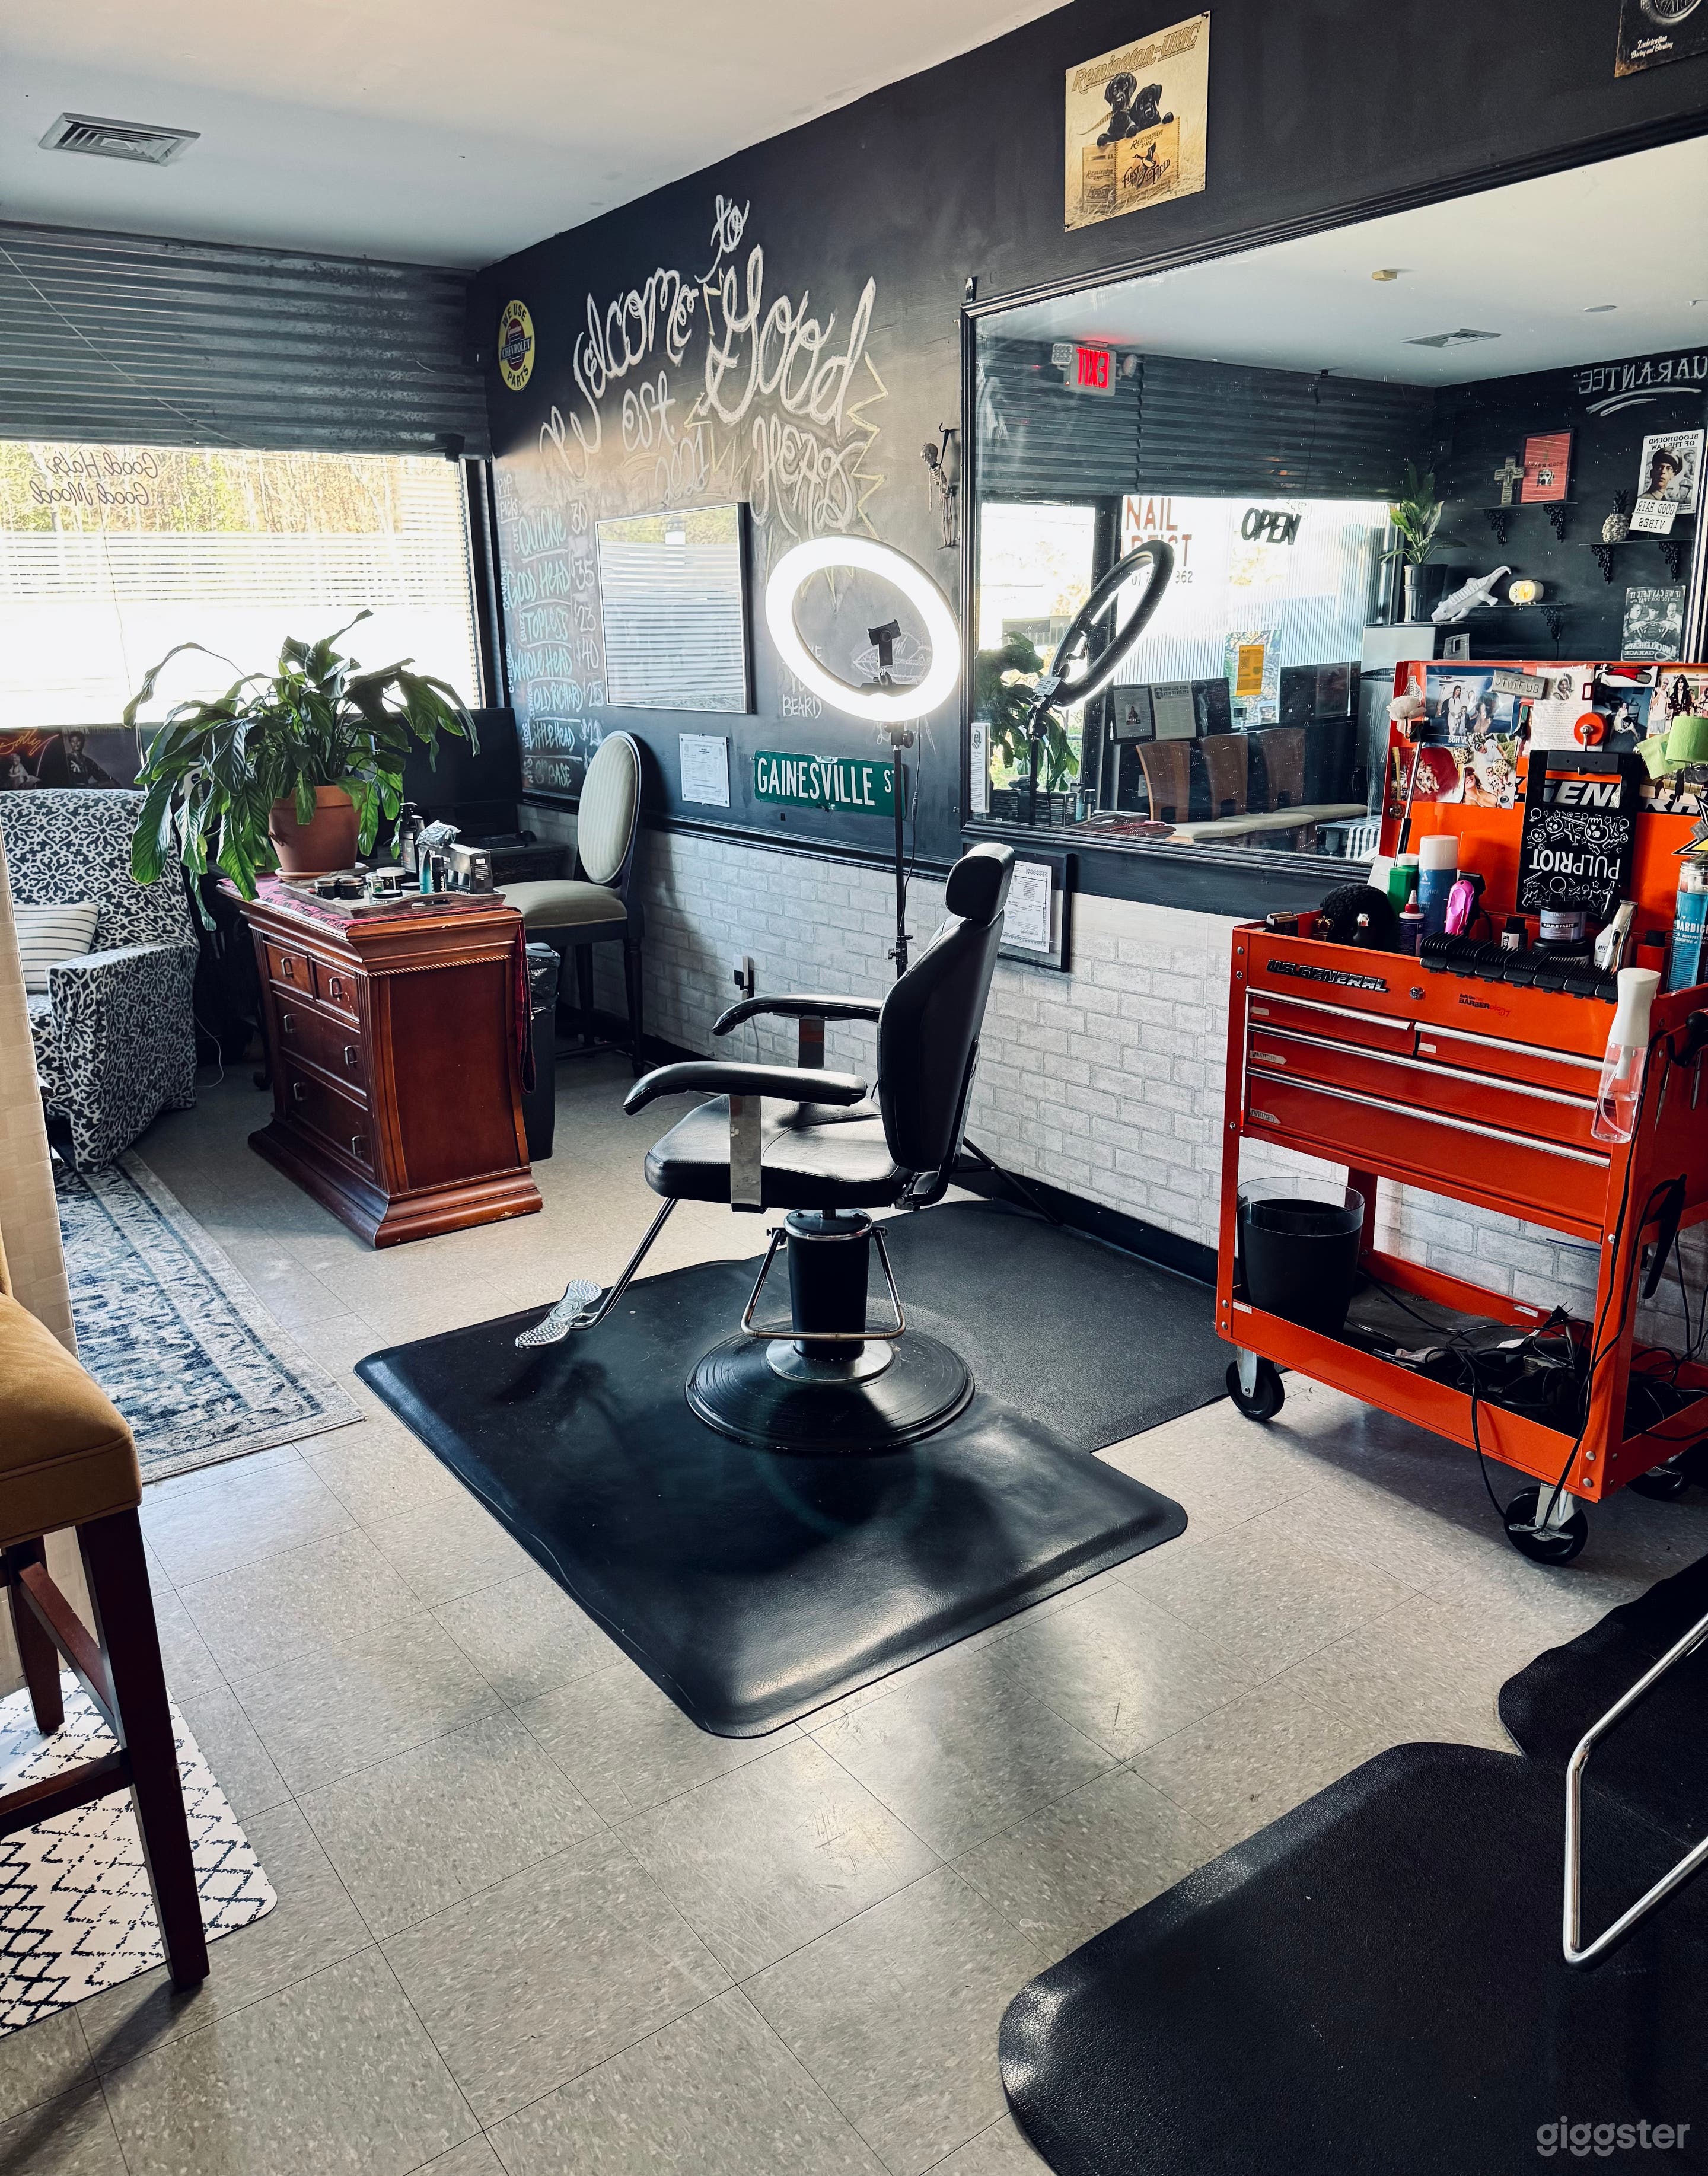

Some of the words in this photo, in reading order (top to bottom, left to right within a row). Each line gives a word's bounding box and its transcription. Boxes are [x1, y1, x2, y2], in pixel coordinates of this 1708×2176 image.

[1071, 21, 1202, 95] Remington-UMC
[503, 306, 512, 327] WE
[514, 303, 527, 321] USE
[502, 339, 531, 358] CHEVROLET
[507, 365, 529, 387] PARTS
[1126, 497, 1178, 530] NAIL
[1241, 508, 1302, 545] OPEN
[783, 694, 822, 719] BEARD
[757, 757, 875, 806] GAINESVILLE
[884, 769, 894, 793] S
[1529, 848, 1621, 880] PULPRIOT
[1299, 965, 1387, 992] GENERAL
